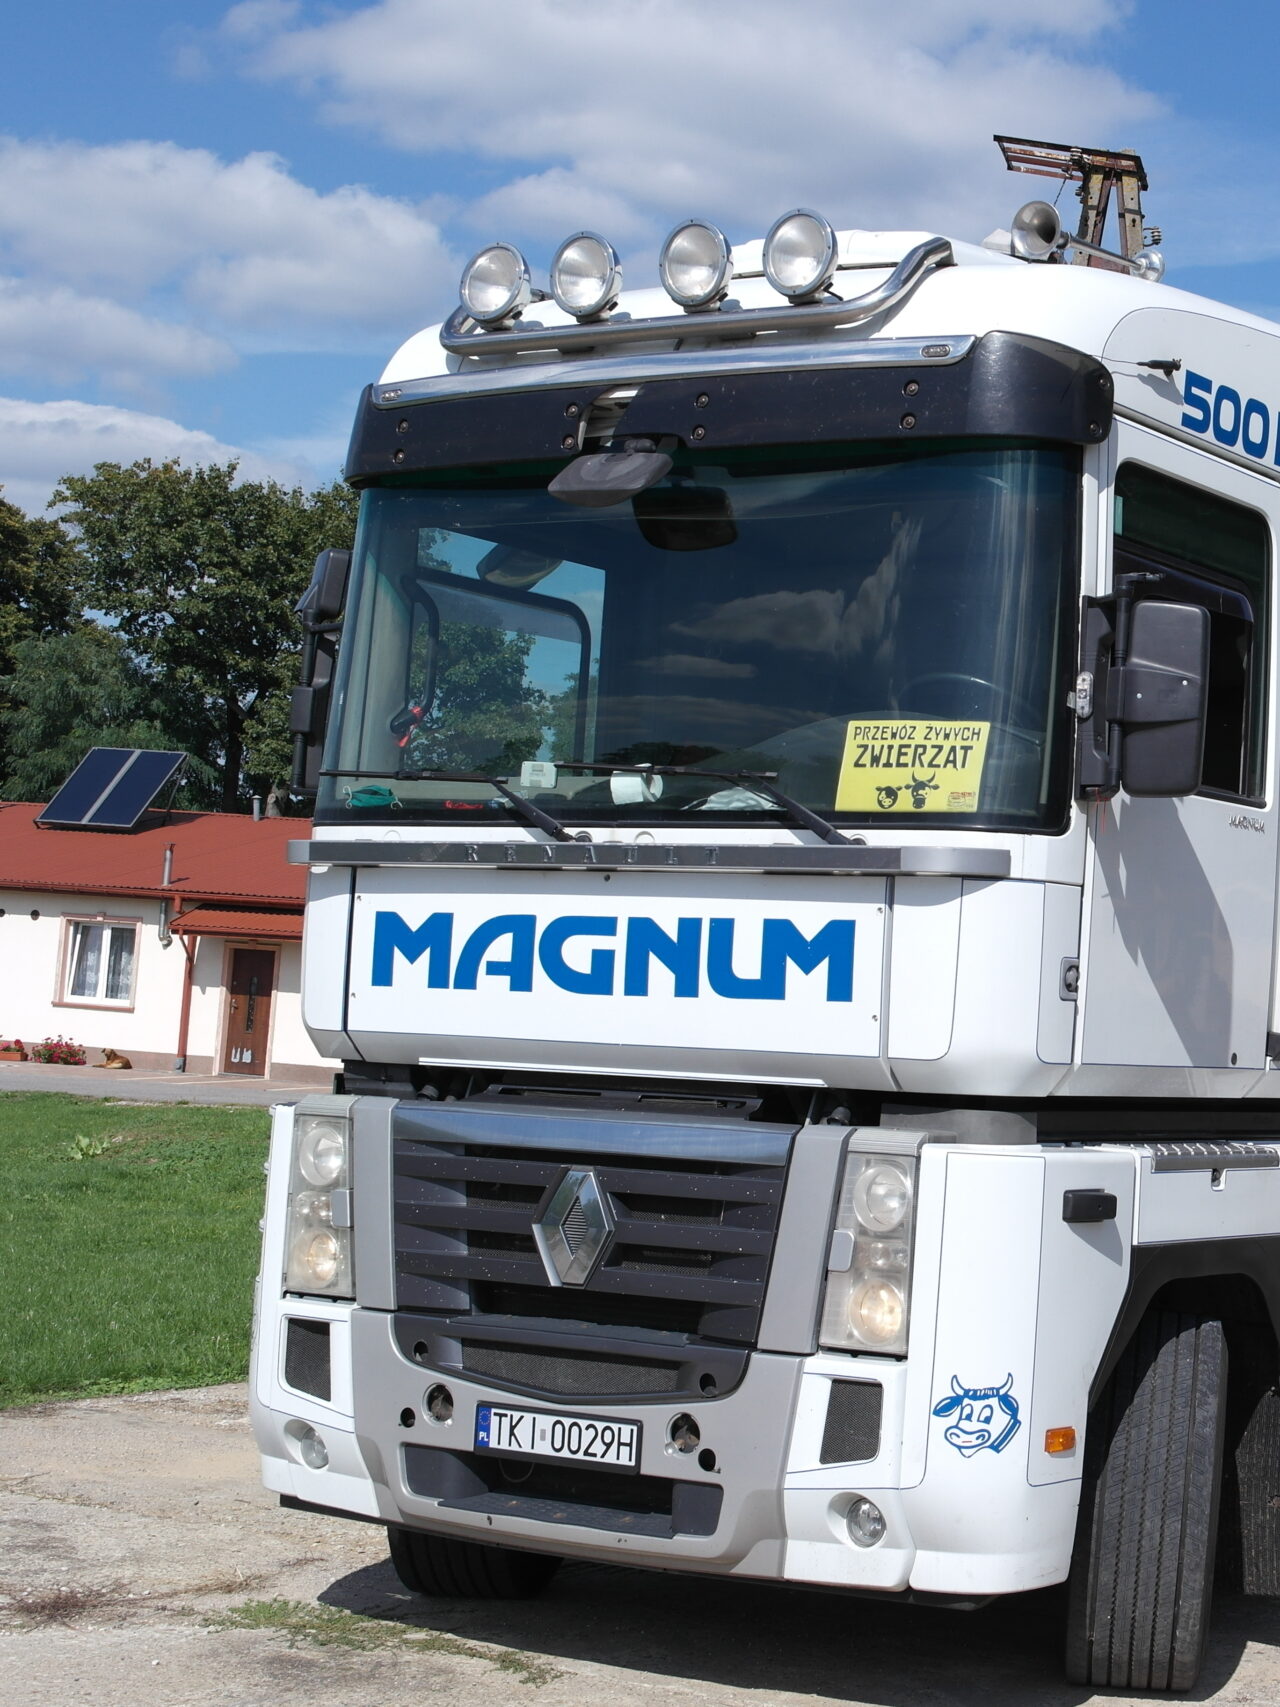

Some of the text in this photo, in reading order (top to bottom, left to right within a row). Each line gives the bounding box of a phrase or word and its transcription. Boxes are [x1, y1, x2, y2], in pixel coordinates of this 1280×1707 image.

[1181, 369, 1270, 459] 500
[853, 723, 982, 742] PRZEWÓZ ŻYWYCH
[853, 743, 974, 771] ZWIERZĄT
[371, 910, 857, 1003] MAGNUM
[478, 1431, 490, 1442] PL
[550, 1419, 634, 1463] 0029H
